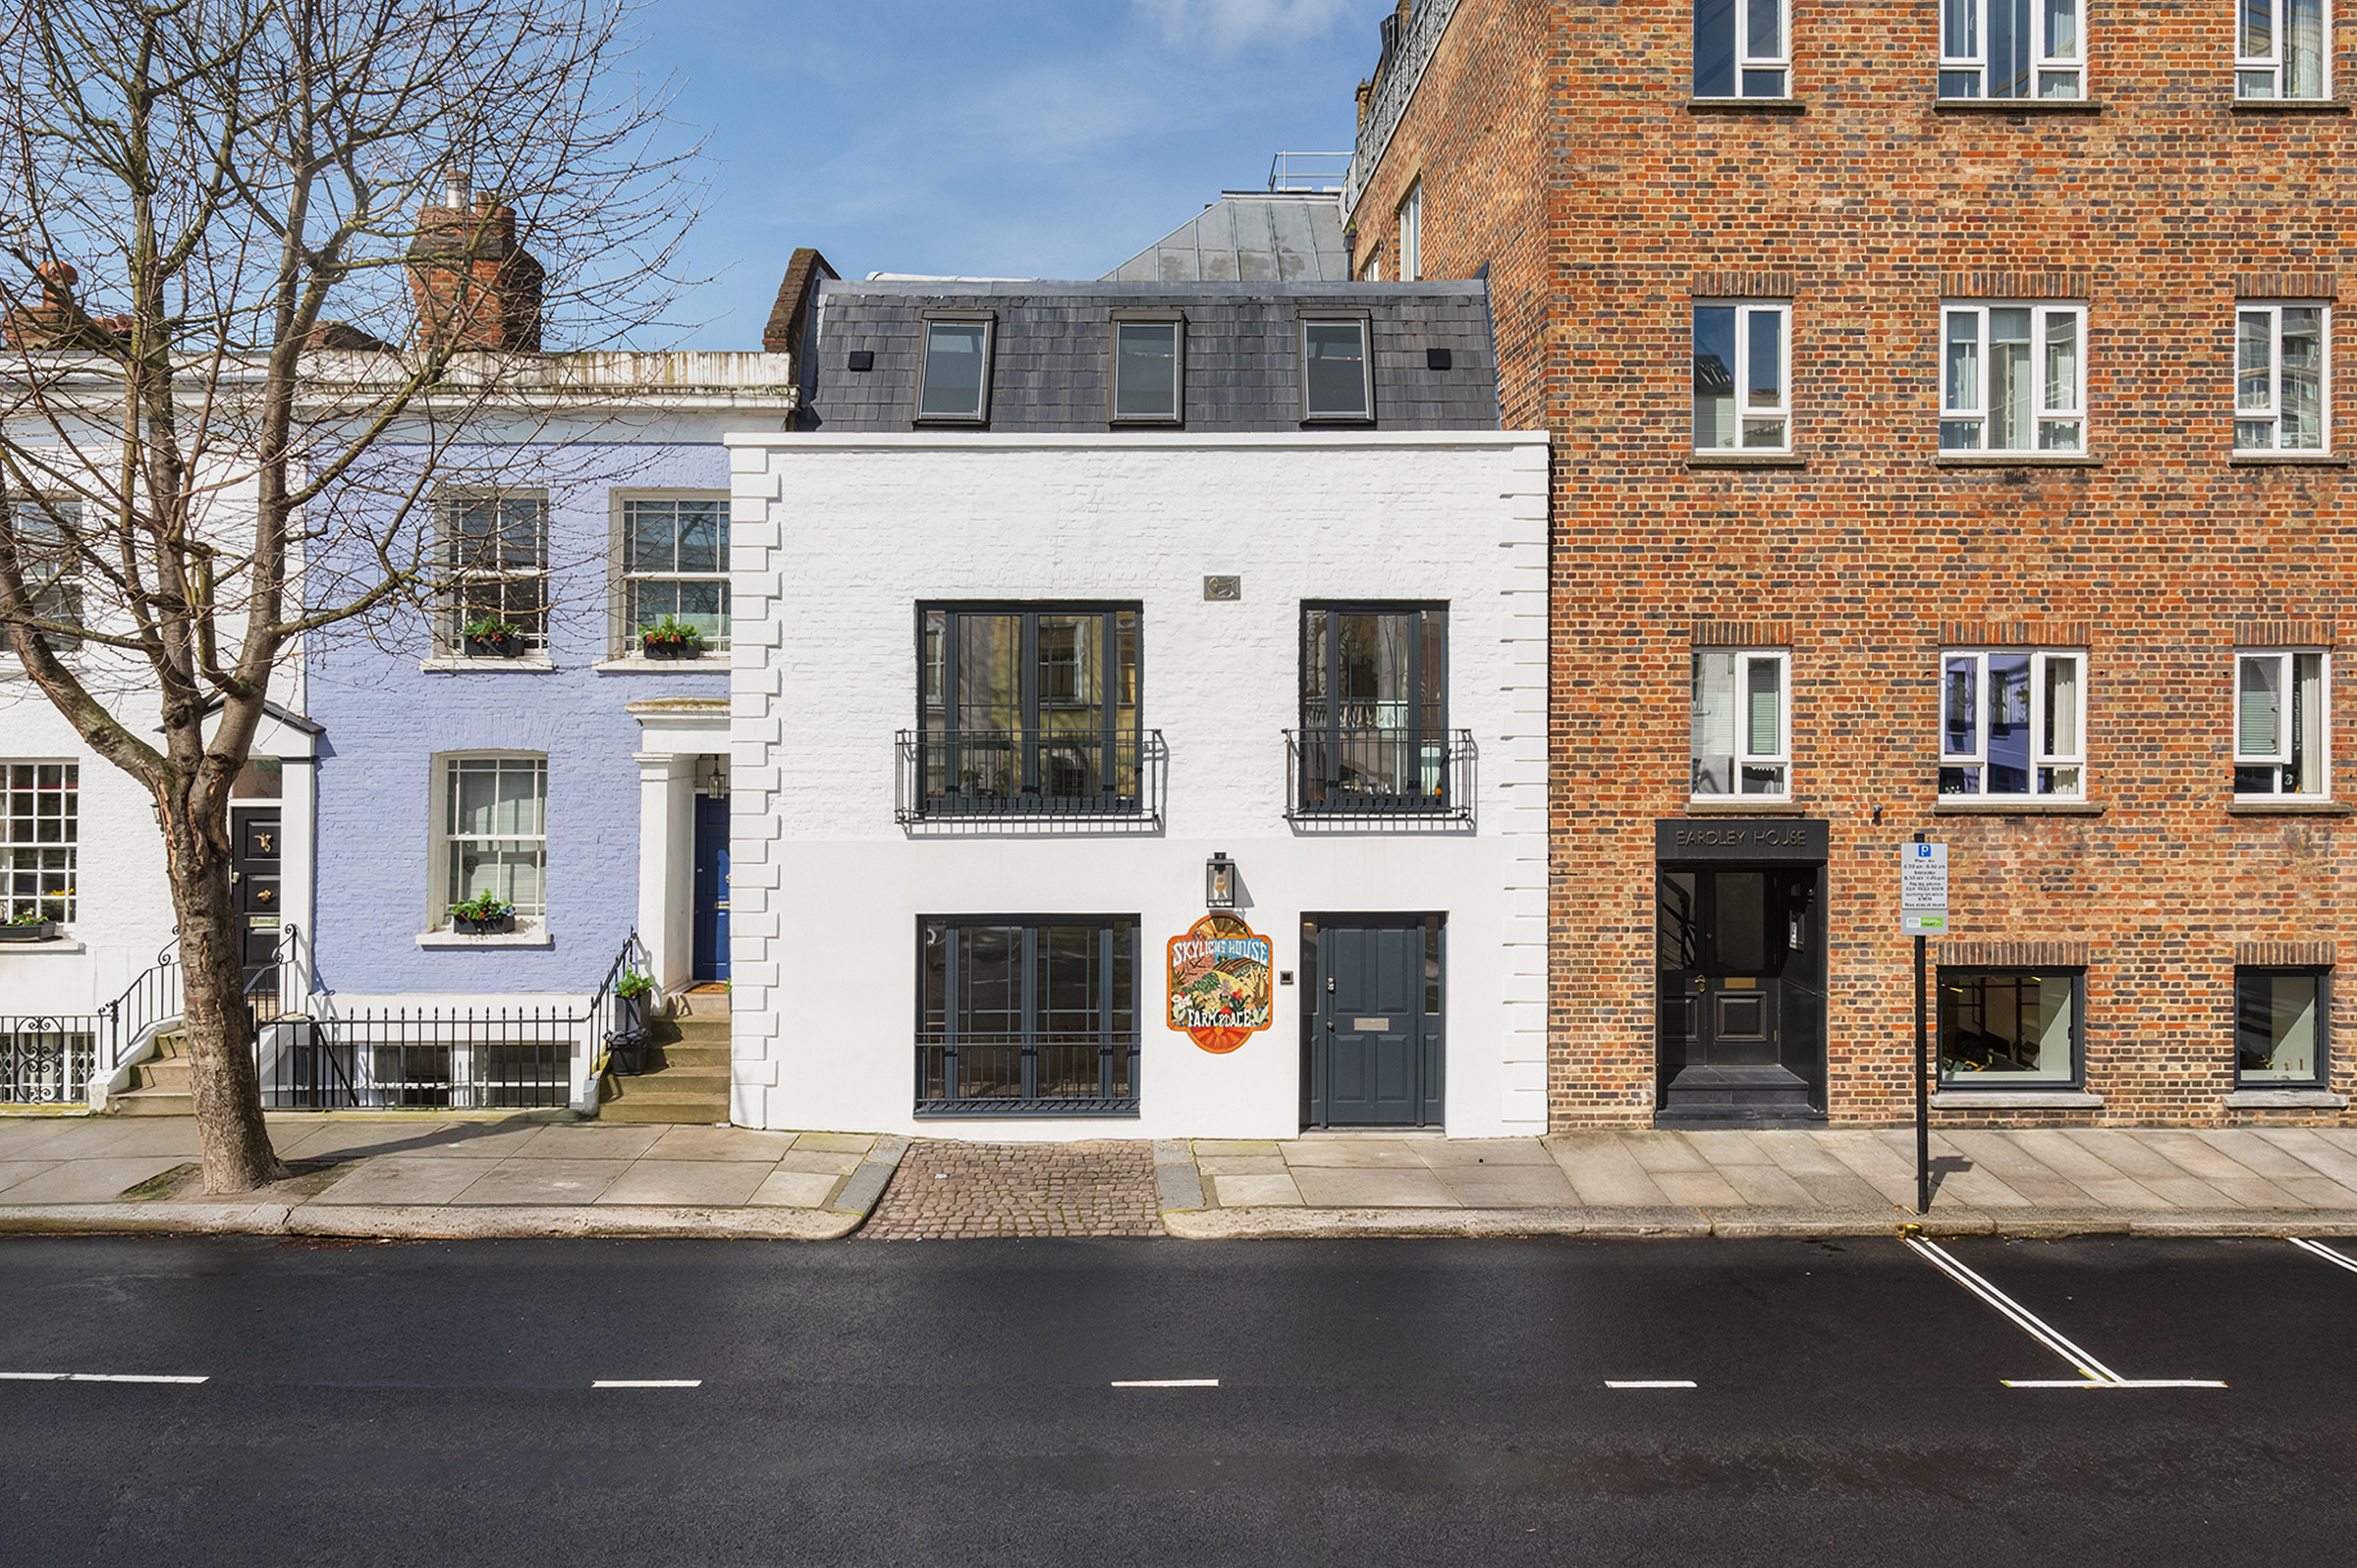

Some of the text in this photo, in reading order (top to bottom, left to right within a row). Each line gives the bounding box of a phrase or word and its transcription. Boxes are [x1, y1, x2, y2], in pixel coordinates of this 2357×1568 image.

[1675, 828, 1807, 846] EARDLEY HOUSE
[1229, 940, 1268, 966] HOUSE
[1187, 1008, 1218, 1028] FARM
